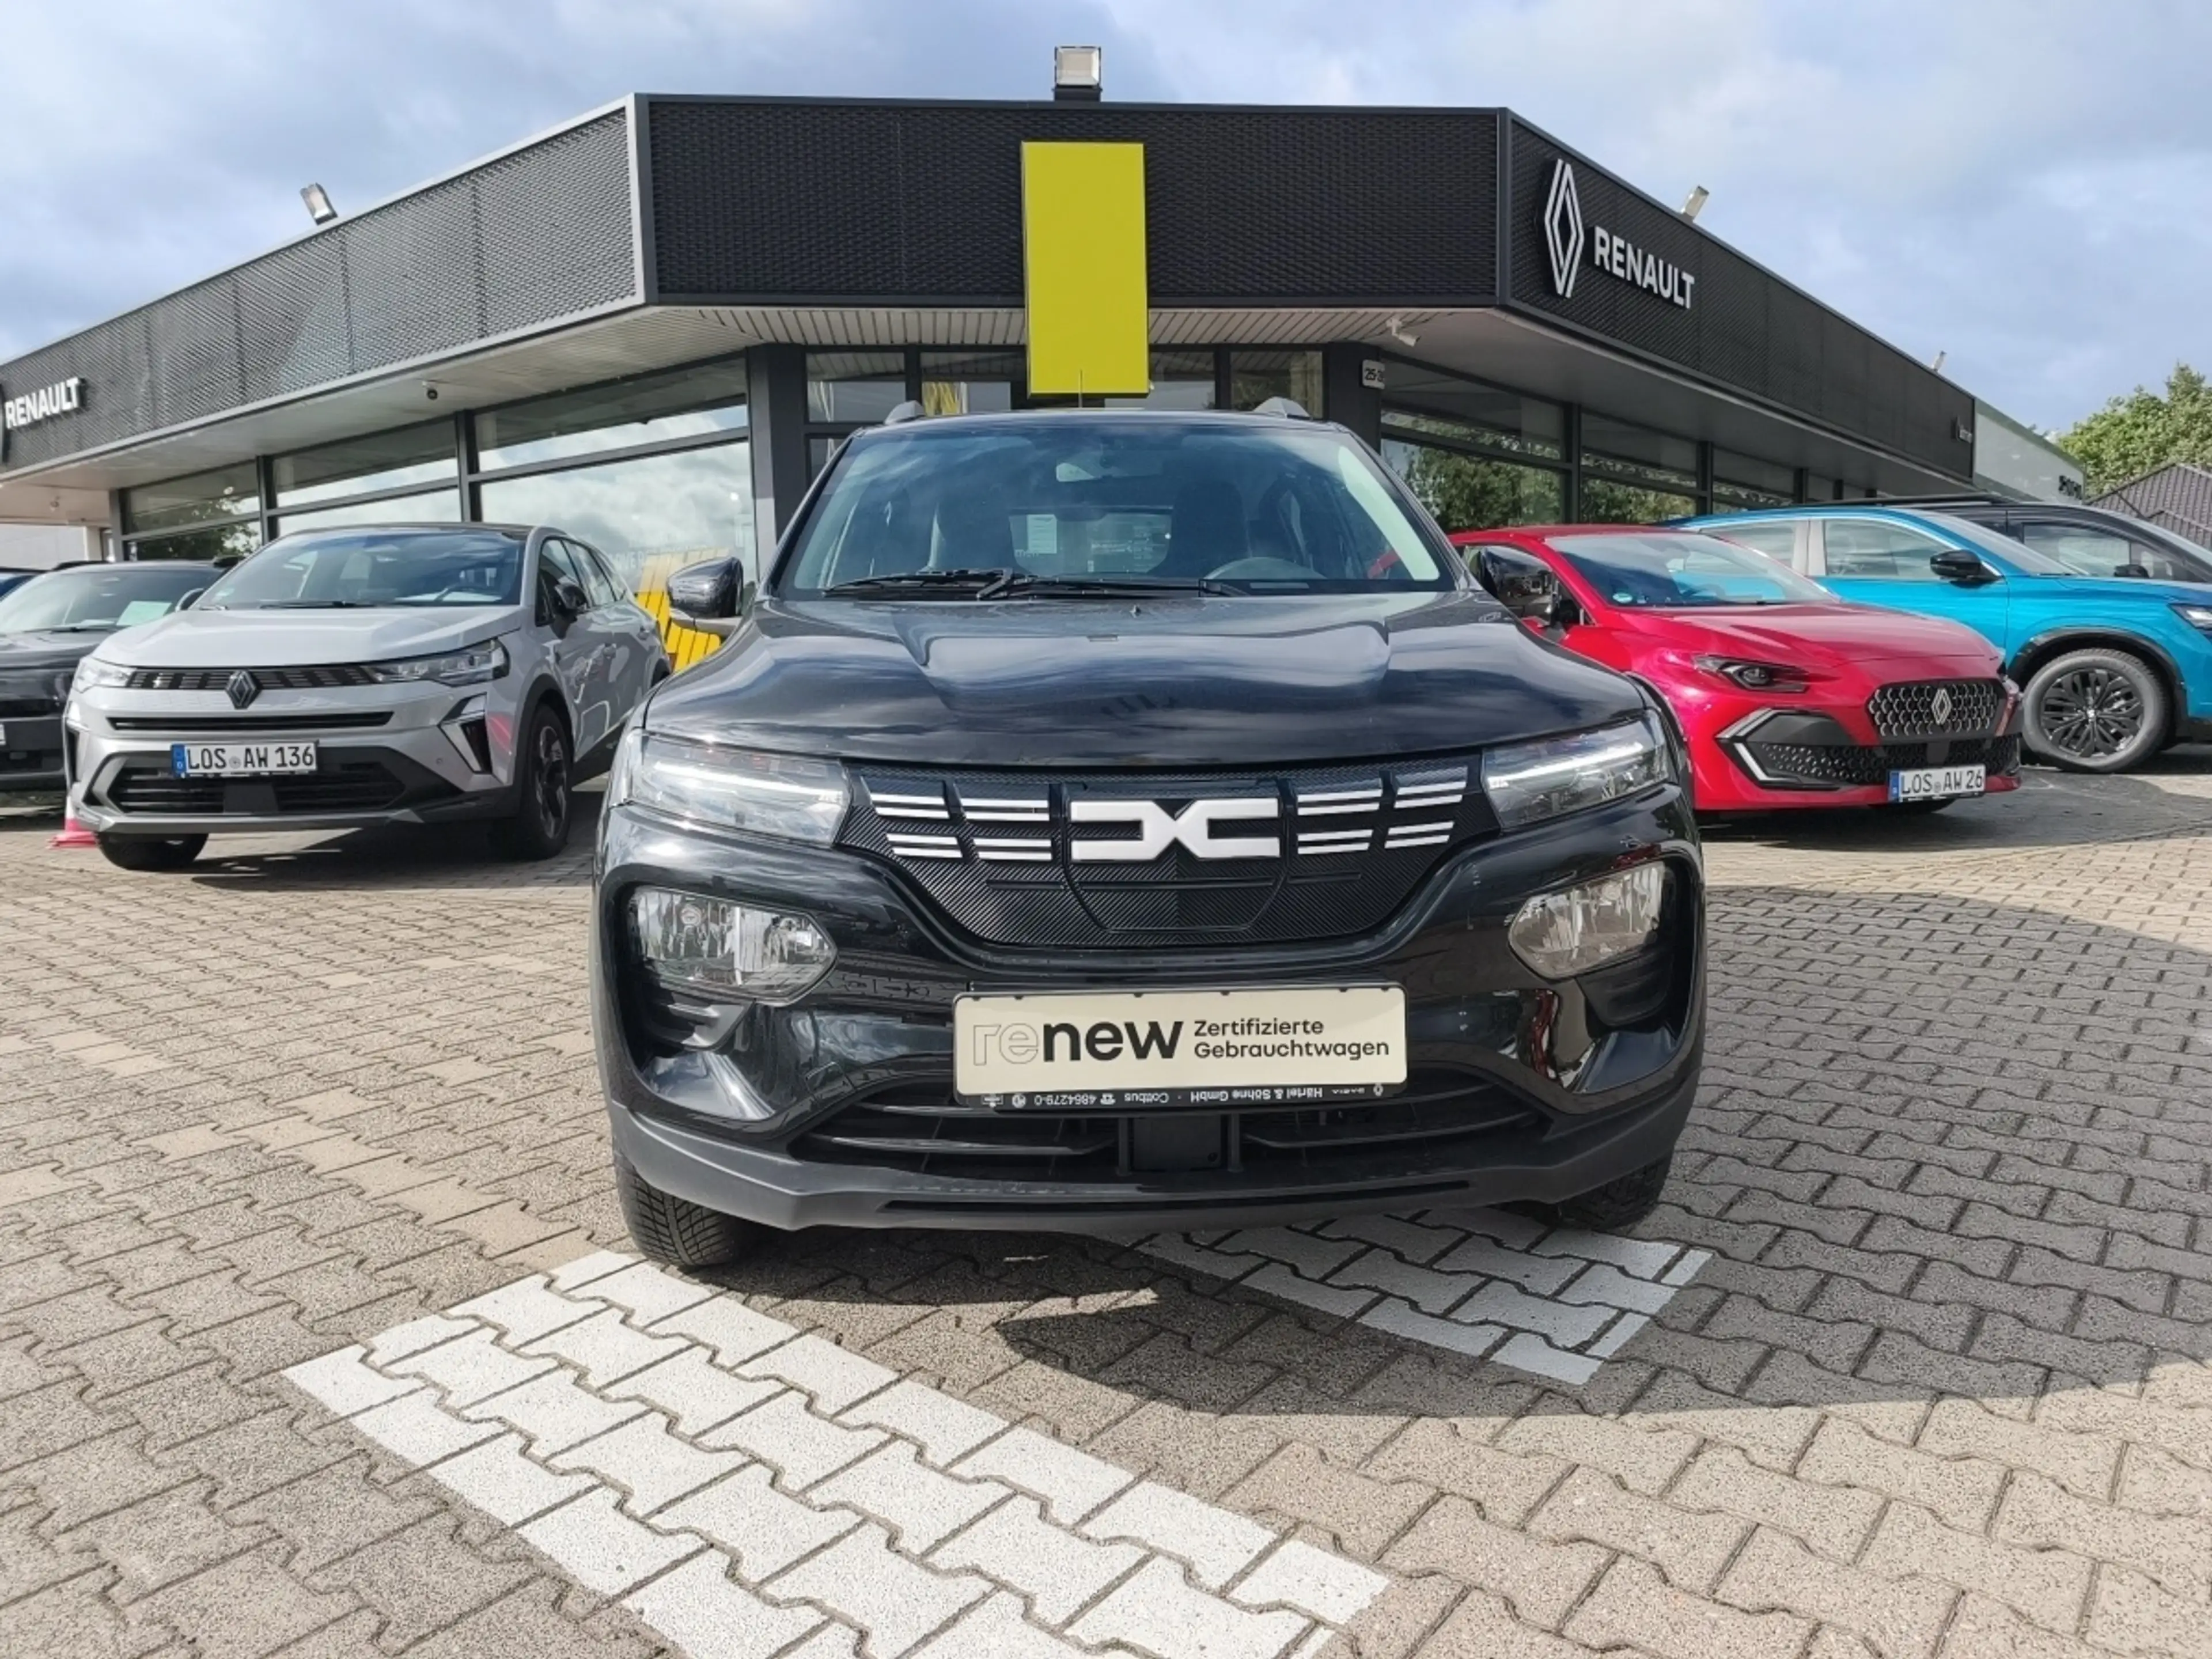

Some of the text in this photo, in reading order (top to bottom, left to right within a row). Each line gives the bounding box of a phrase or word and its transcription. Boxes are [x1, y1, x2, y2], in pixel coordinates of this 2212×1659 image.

[1595, 225, 1695, 309] RENAULT
[5, 376, 79, 429] RENAULT
[187, 746, 314, 770] LOS AW 136
[1902, 770, 1983, 794] LOS AW 26
[1194, 1017, 1324, 1036] Zertifizierte
[973, 1021, 1184, 1066] renew
[1194, 1040, 1390, 1061] Gebrauchtwagen
[1124, 1092, 1169, 1104] Cottbus
[1190, 1090, 1229, 1103] GmbH
[1232, 1089, 1271, 1101] Söhne
[1274, 1088, 1284, 1100] &
[1286, 1087, 1323, 1100] Härtel
